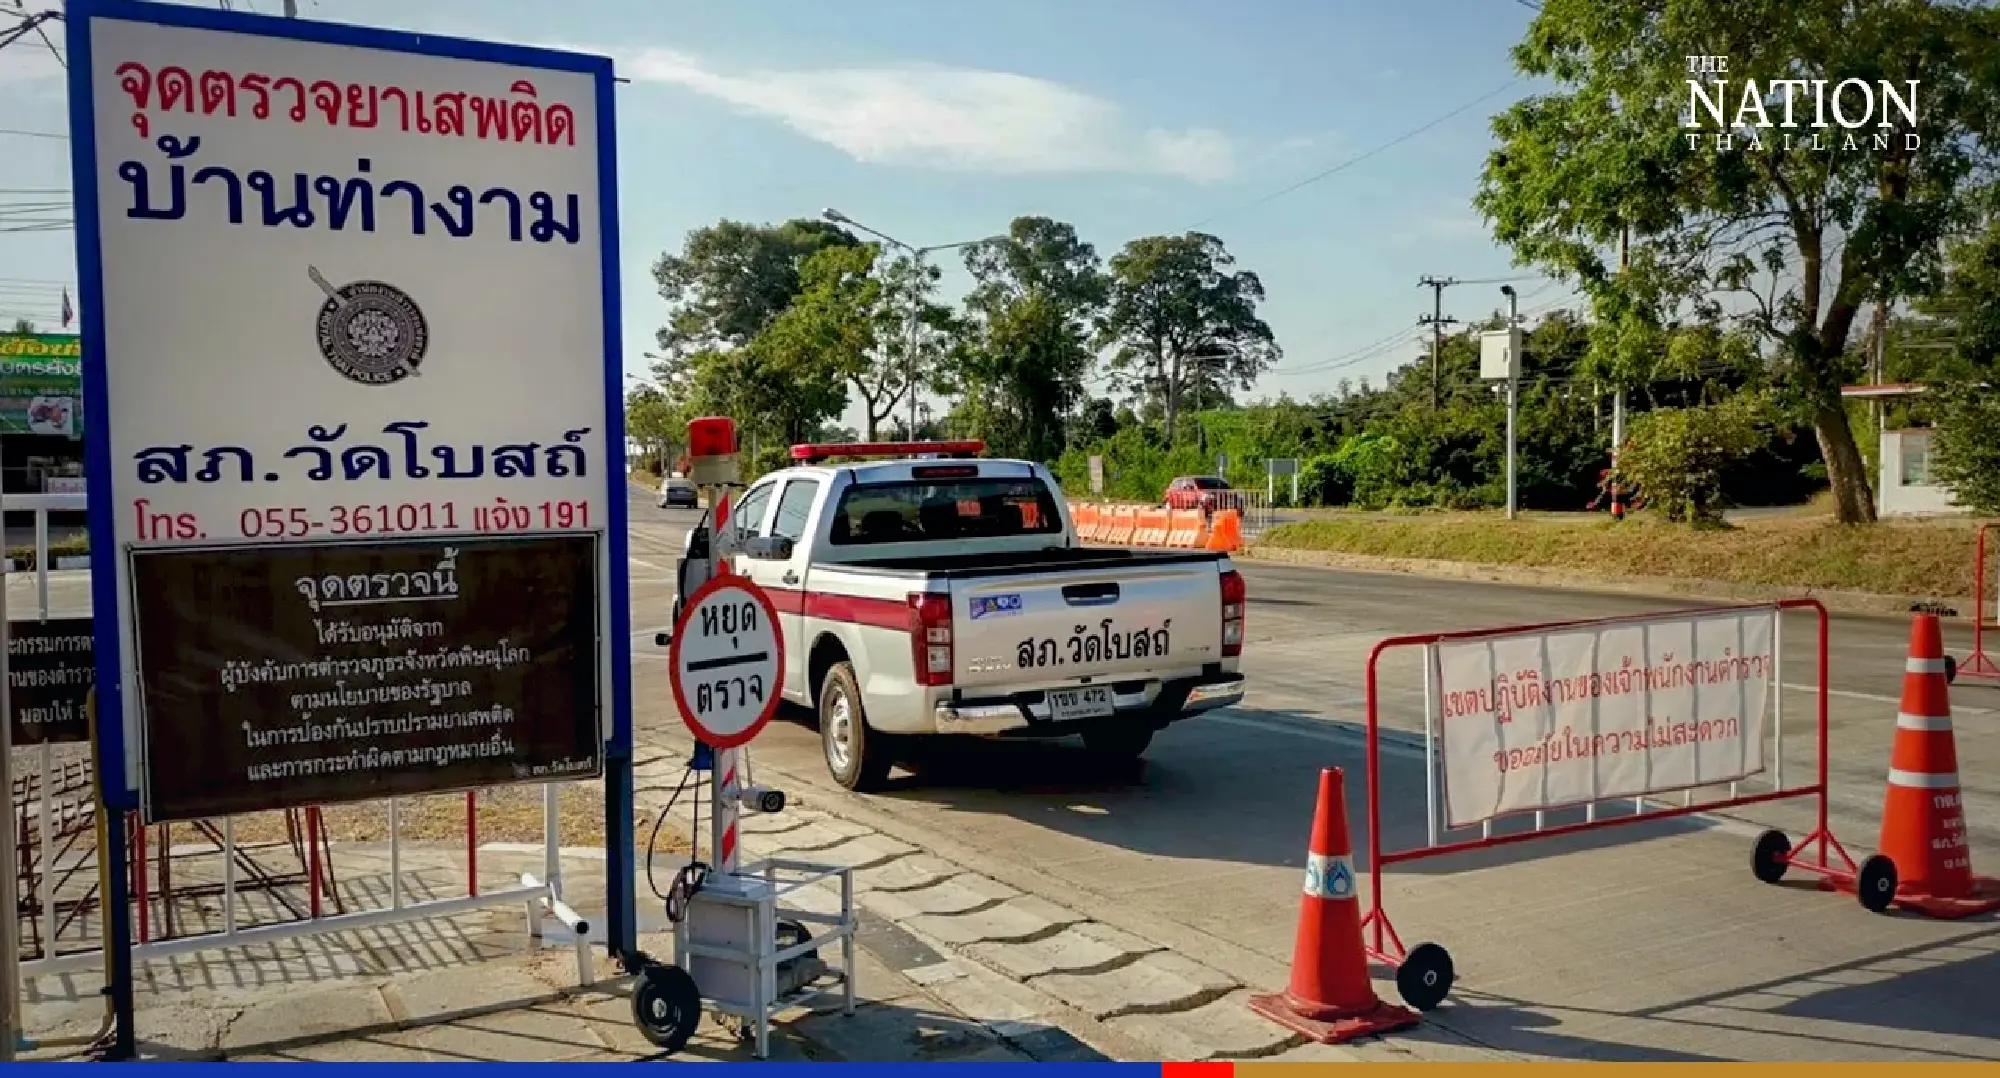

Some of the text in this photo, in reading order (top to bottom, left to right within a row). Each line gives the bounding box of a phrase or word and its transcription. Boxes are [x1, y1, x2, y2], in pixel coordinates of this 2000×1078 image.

[116, 61, 576, 146] จุดตรวจยาเสพติด
[118, 135, 580, 244] บ้านท่างาม
[134, 422, 592, 484] สภ.วัดโบสถ์
[135, 498, 590, 540] โทร. 055-361011 แจ้ง 191
[295, 547, 459, 612] จุดตรวจนี้
[312, 618, 445, 647] ได้รับอนุมัติจาก
[701, 602, 757, 650] หยุด
[1017, 617, 1172, 669] สภ.วัดโบสถ์
[291, 679, 473, 709] ตามนโยบายของรัฐบาล
[697, 674, 763, 715] ตรวจ
[1493, 715, 1738, 773] ขออภัยในความไม่สะดวก
